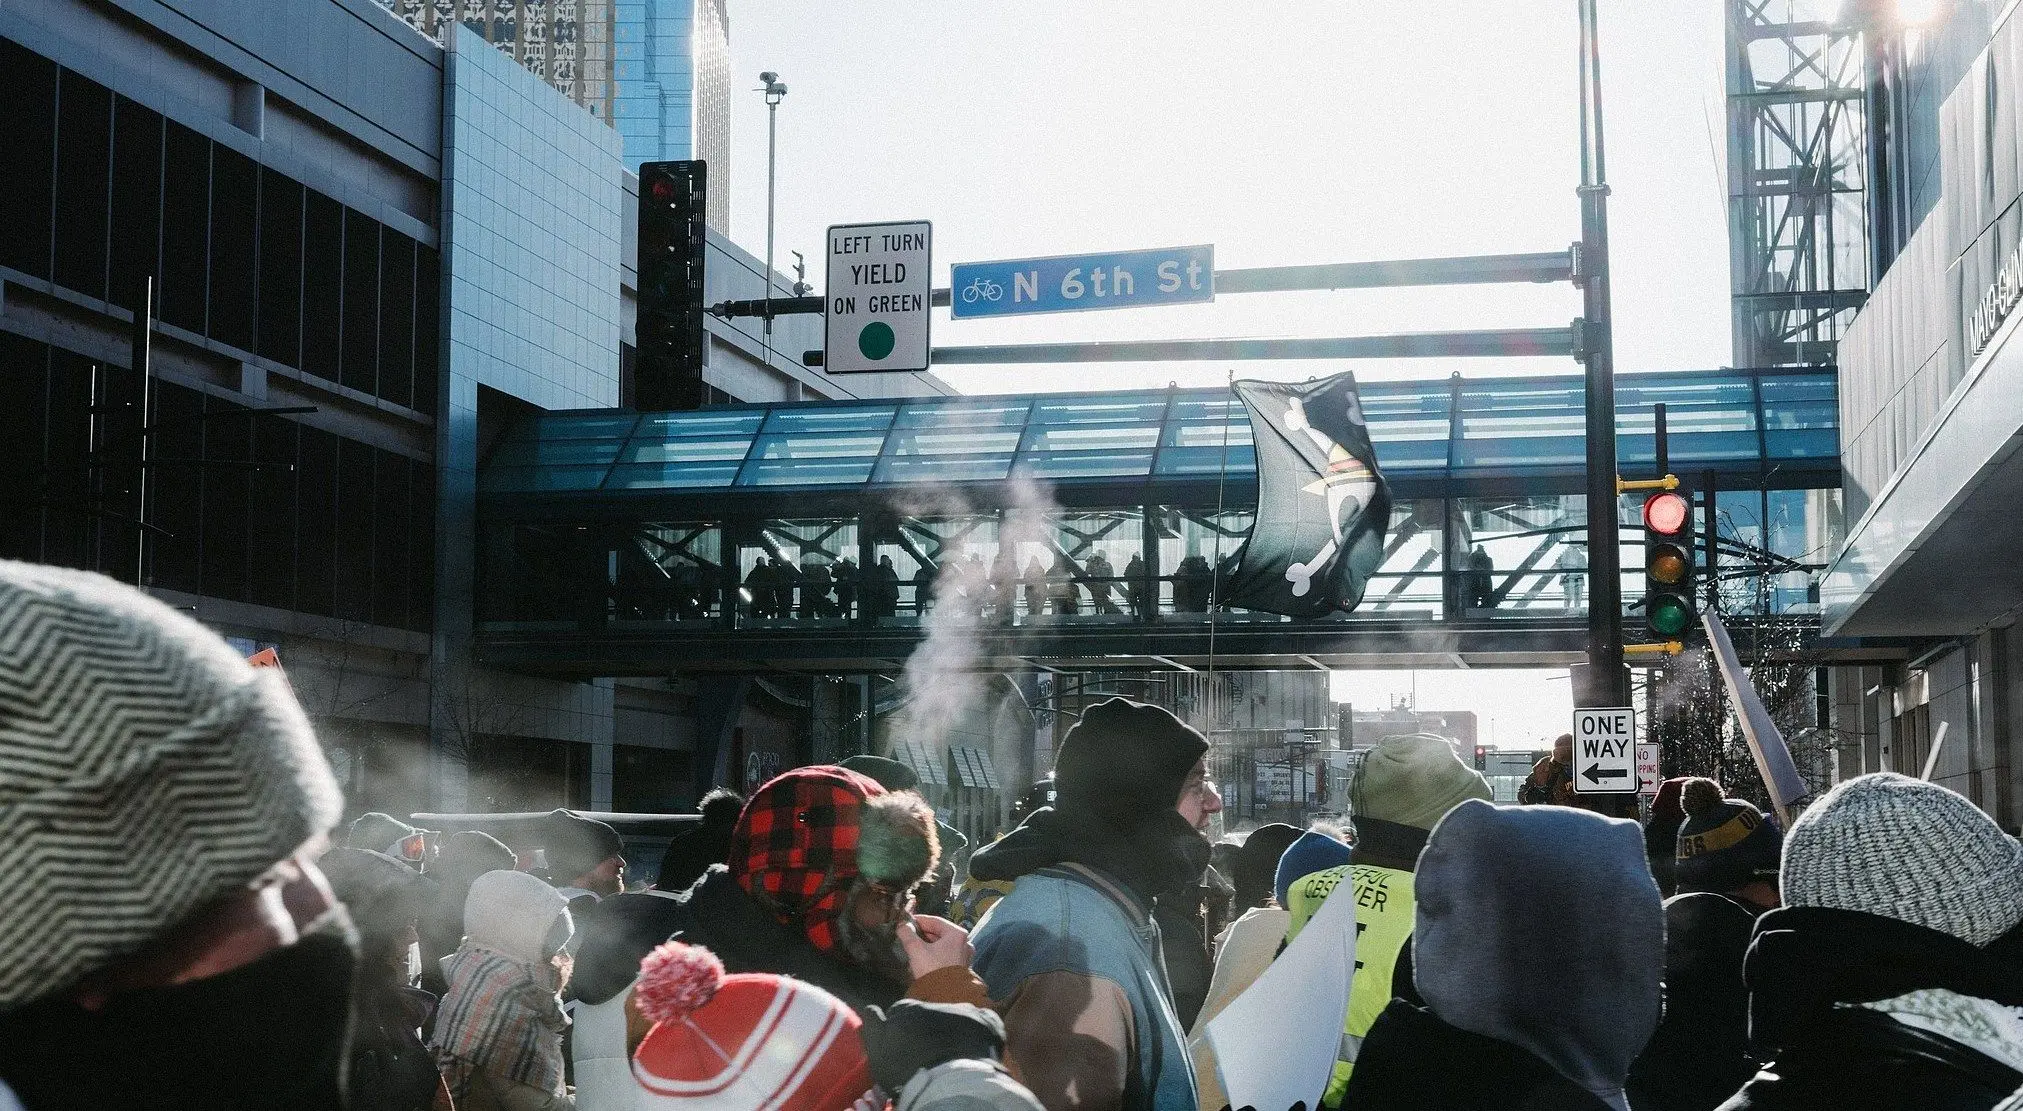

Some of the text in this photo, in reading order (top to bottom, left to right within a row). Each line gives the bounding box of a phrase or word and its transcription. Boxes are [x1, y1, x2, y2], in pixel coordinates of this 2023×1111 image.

[834, 233, 924, 254] LEFT TURN
[851, 263, 906, 285] YIELD
[1013, 258, 1202, 303] N 6th St
[834, 294, 922, 315] ON GREEN
[1969, 283, 1996, 355] MAYO
[1582, 716, 1627, 735] ONE
[1583, 739, 1629, 758] WAY
[1638, 764, 1656, 774] PPING
[1305, 879, 1387, 912] OBSER
